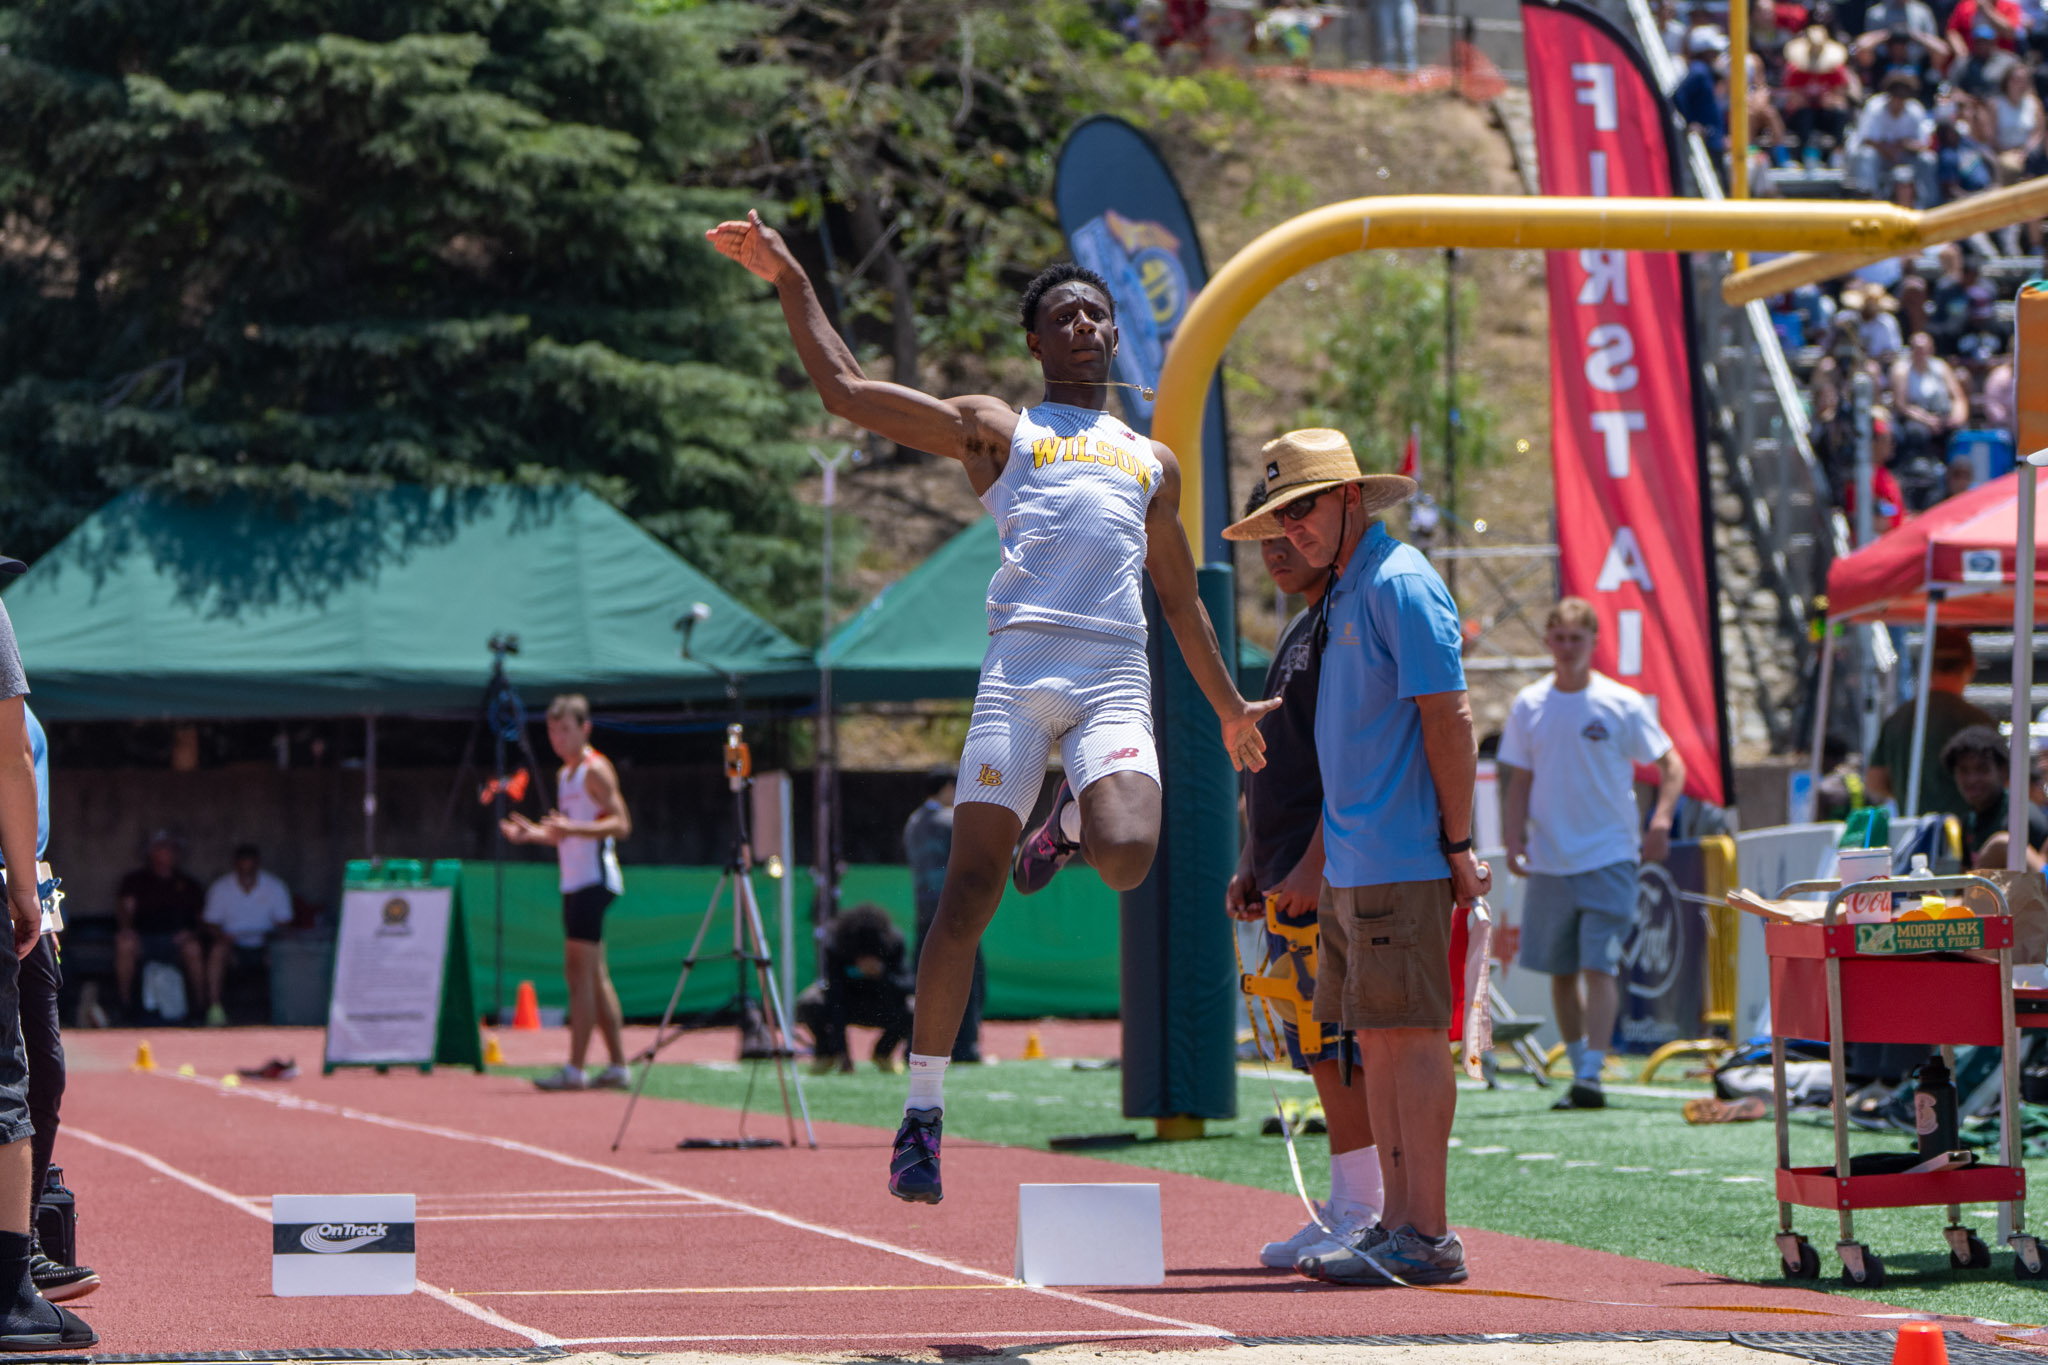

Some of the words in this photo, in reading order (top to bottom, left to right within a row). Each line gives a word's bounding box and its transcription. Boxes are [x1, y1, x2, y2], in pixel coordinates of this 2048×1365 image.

[1032, 435, 1151, 494] WILSON
[1897, 921, 1979, 938] MOORPARK
[1897, 937, 1934, 949] TRACK
[1937, 937, 1945, 948] &
[1948, 935, 1981, 947] FIELD
[318, 1222, 389, 1237] OnTrack
